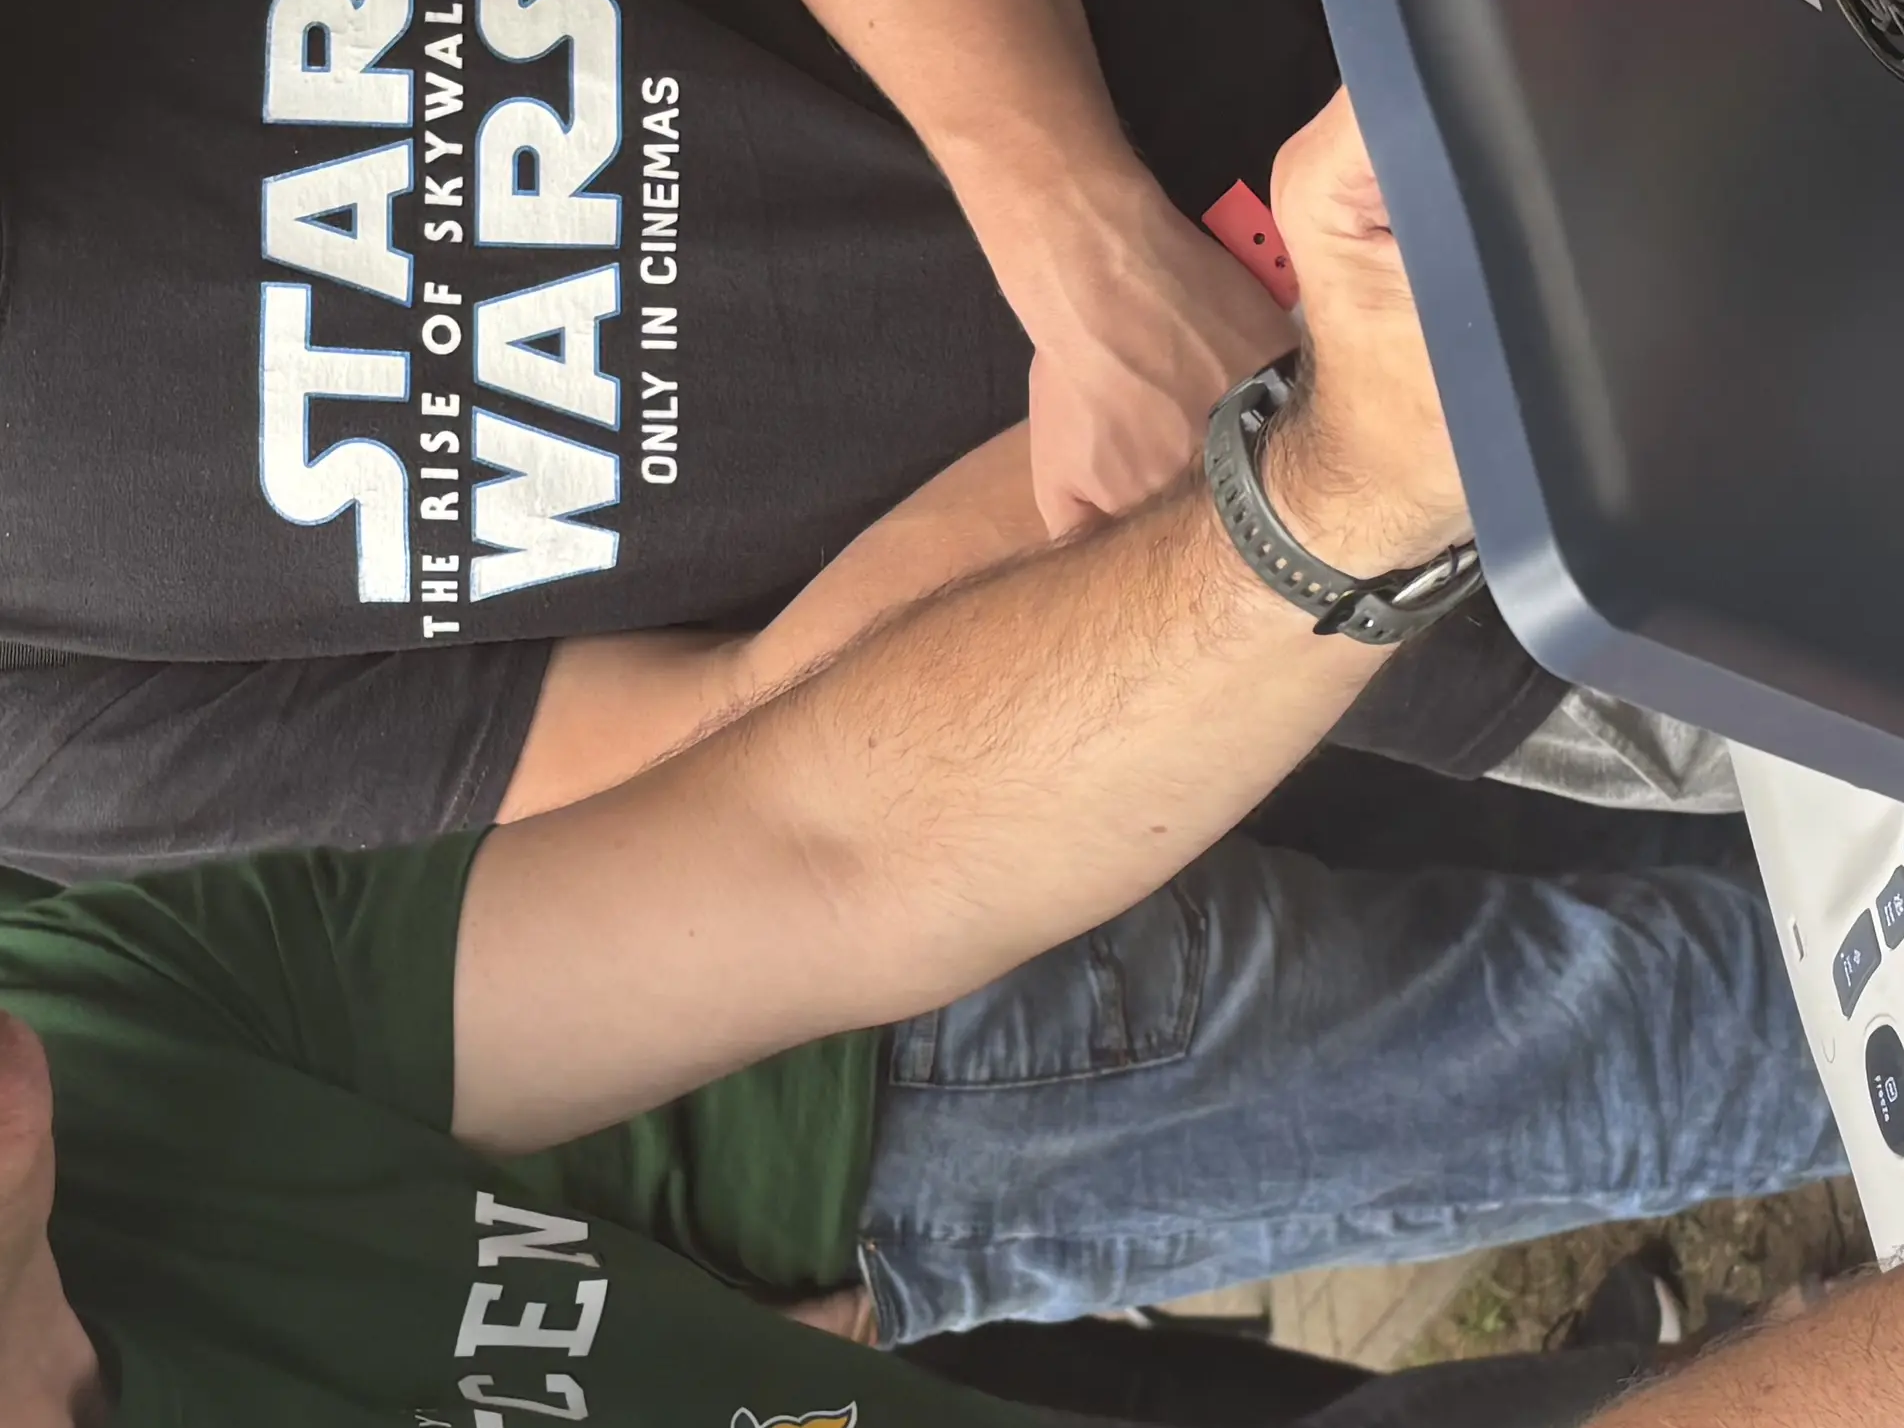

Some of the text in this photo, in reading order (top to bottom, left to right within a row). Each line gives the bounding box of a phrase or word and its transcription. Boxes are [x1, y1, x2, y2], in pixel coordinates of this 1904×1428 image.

[421, 281, 463, 355] OF
[640, 76, 681, 485] ONLY IN CINEMAS
[421, 392, 461, 521] RISE
[422, 553, 461, 638] THE
